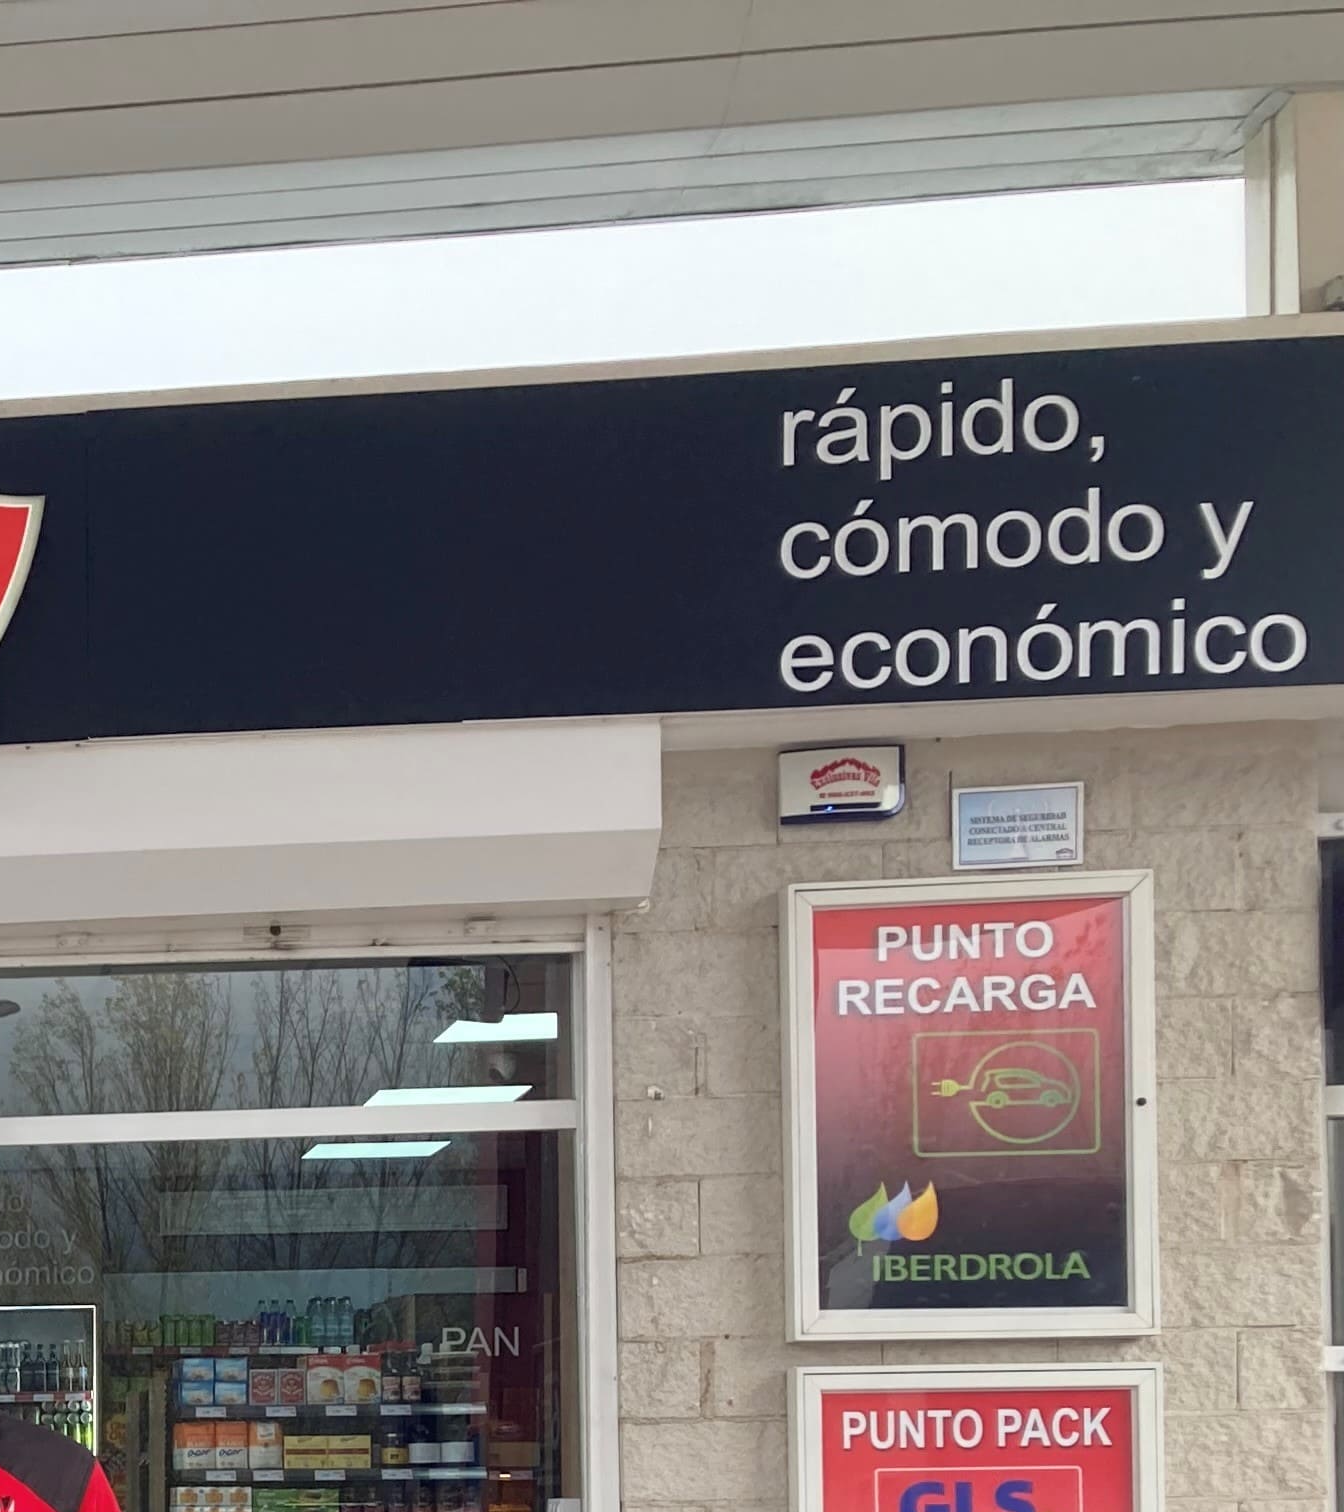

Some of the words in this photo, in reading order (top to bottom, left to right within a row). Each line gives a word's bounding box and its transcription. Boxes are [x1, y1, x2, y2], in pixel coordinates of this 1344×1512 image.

[782, 378, 1106, 481] rápido,
[780, 487, 1164, 580] cómodo
[1199, 501, 1254, 580] y
[780, 598, 1308, 692] económico
[877, 920, 1054, 962] PUNTO
[837, 973, 1097, 1016] RECARGA
[872, 1251, 1091, 1283] IBERDROLA
[441, 1326, 519, 1357] PAN
[841, 1408, 983, 1450] PUNTO
[996, 1407, 1112, 1449] PACK
